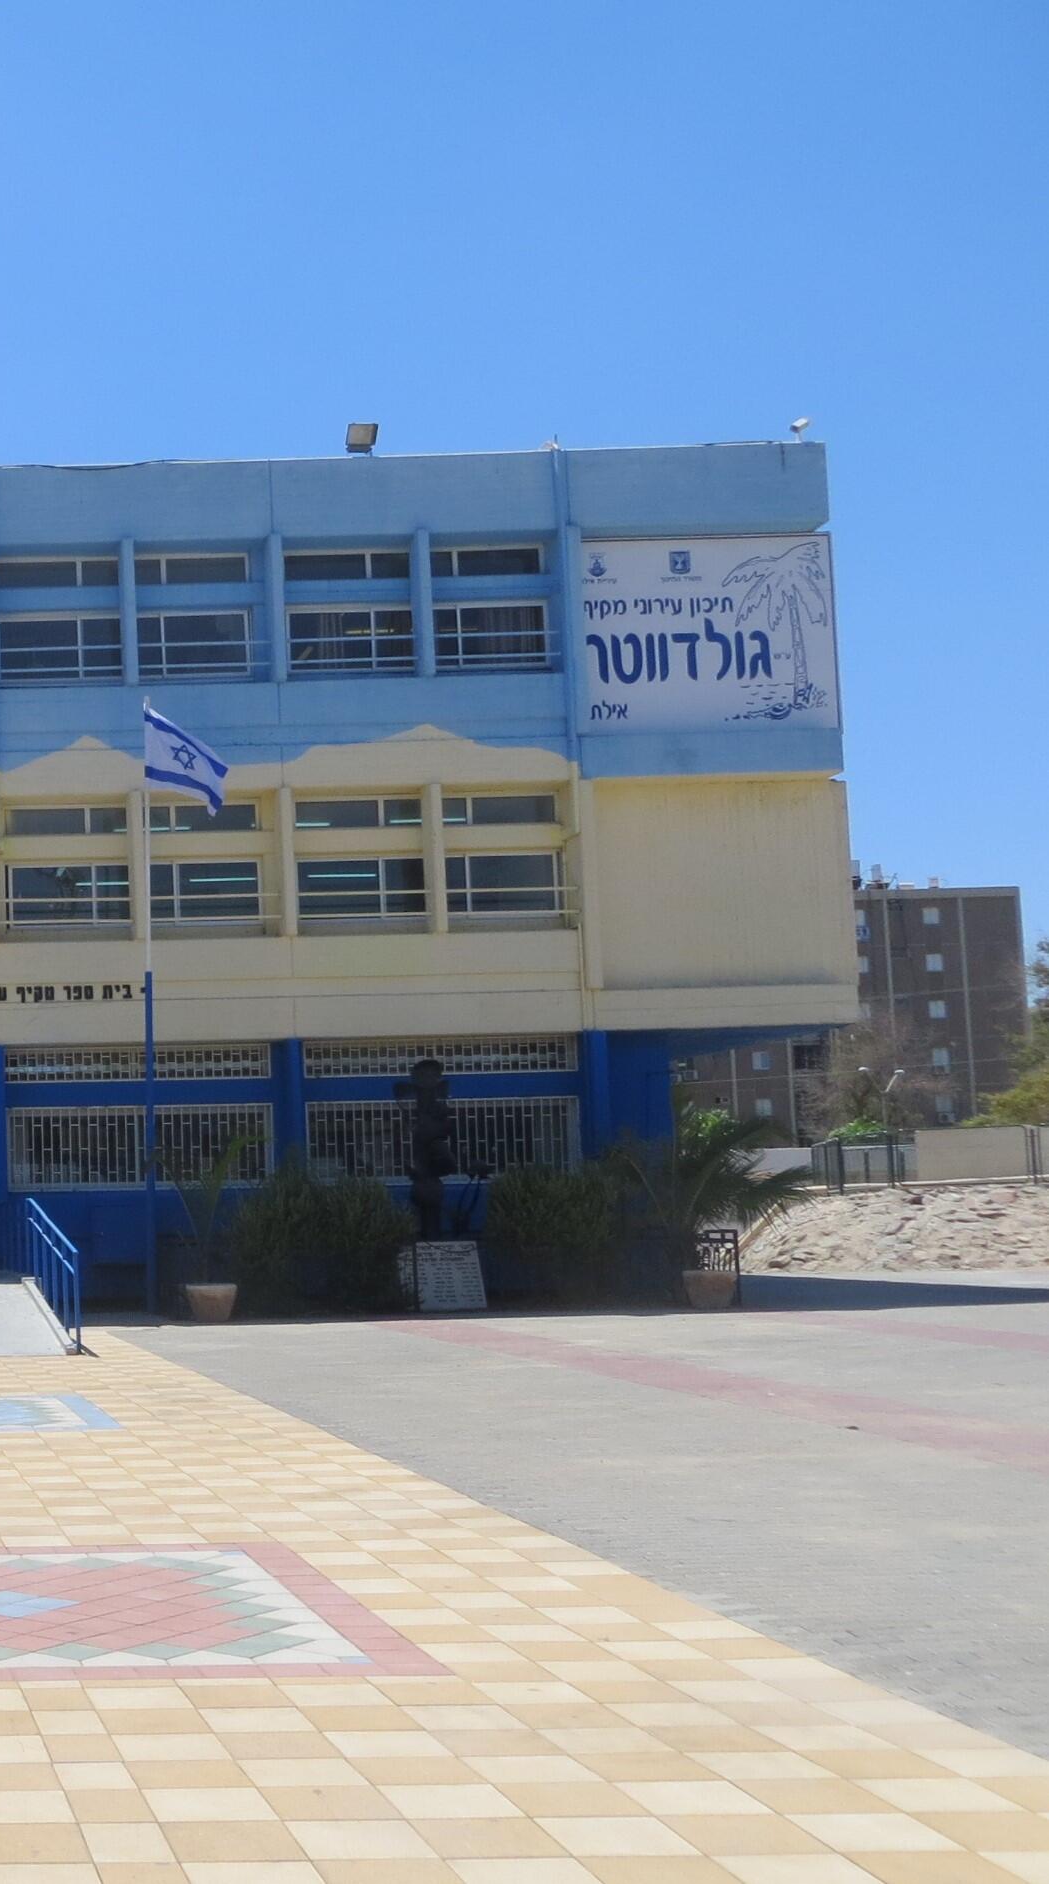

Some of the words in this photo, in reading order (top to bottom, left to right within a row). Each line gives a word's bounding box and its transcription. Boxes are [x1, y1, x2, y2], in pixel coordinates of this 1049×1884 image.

[583, 599, 627, 620] מקיף
[633, 598, 683, 616] עירוני
[690, 597, 734, 618] תיכון
[586, 617, 773, 685] גולדווטר
[590, 700, 629, 721] אילת
[16, 985, 55, 1003] מקיף
[63, 985, 94, 1000] ספר
[102, 984, 133, 999] בית
